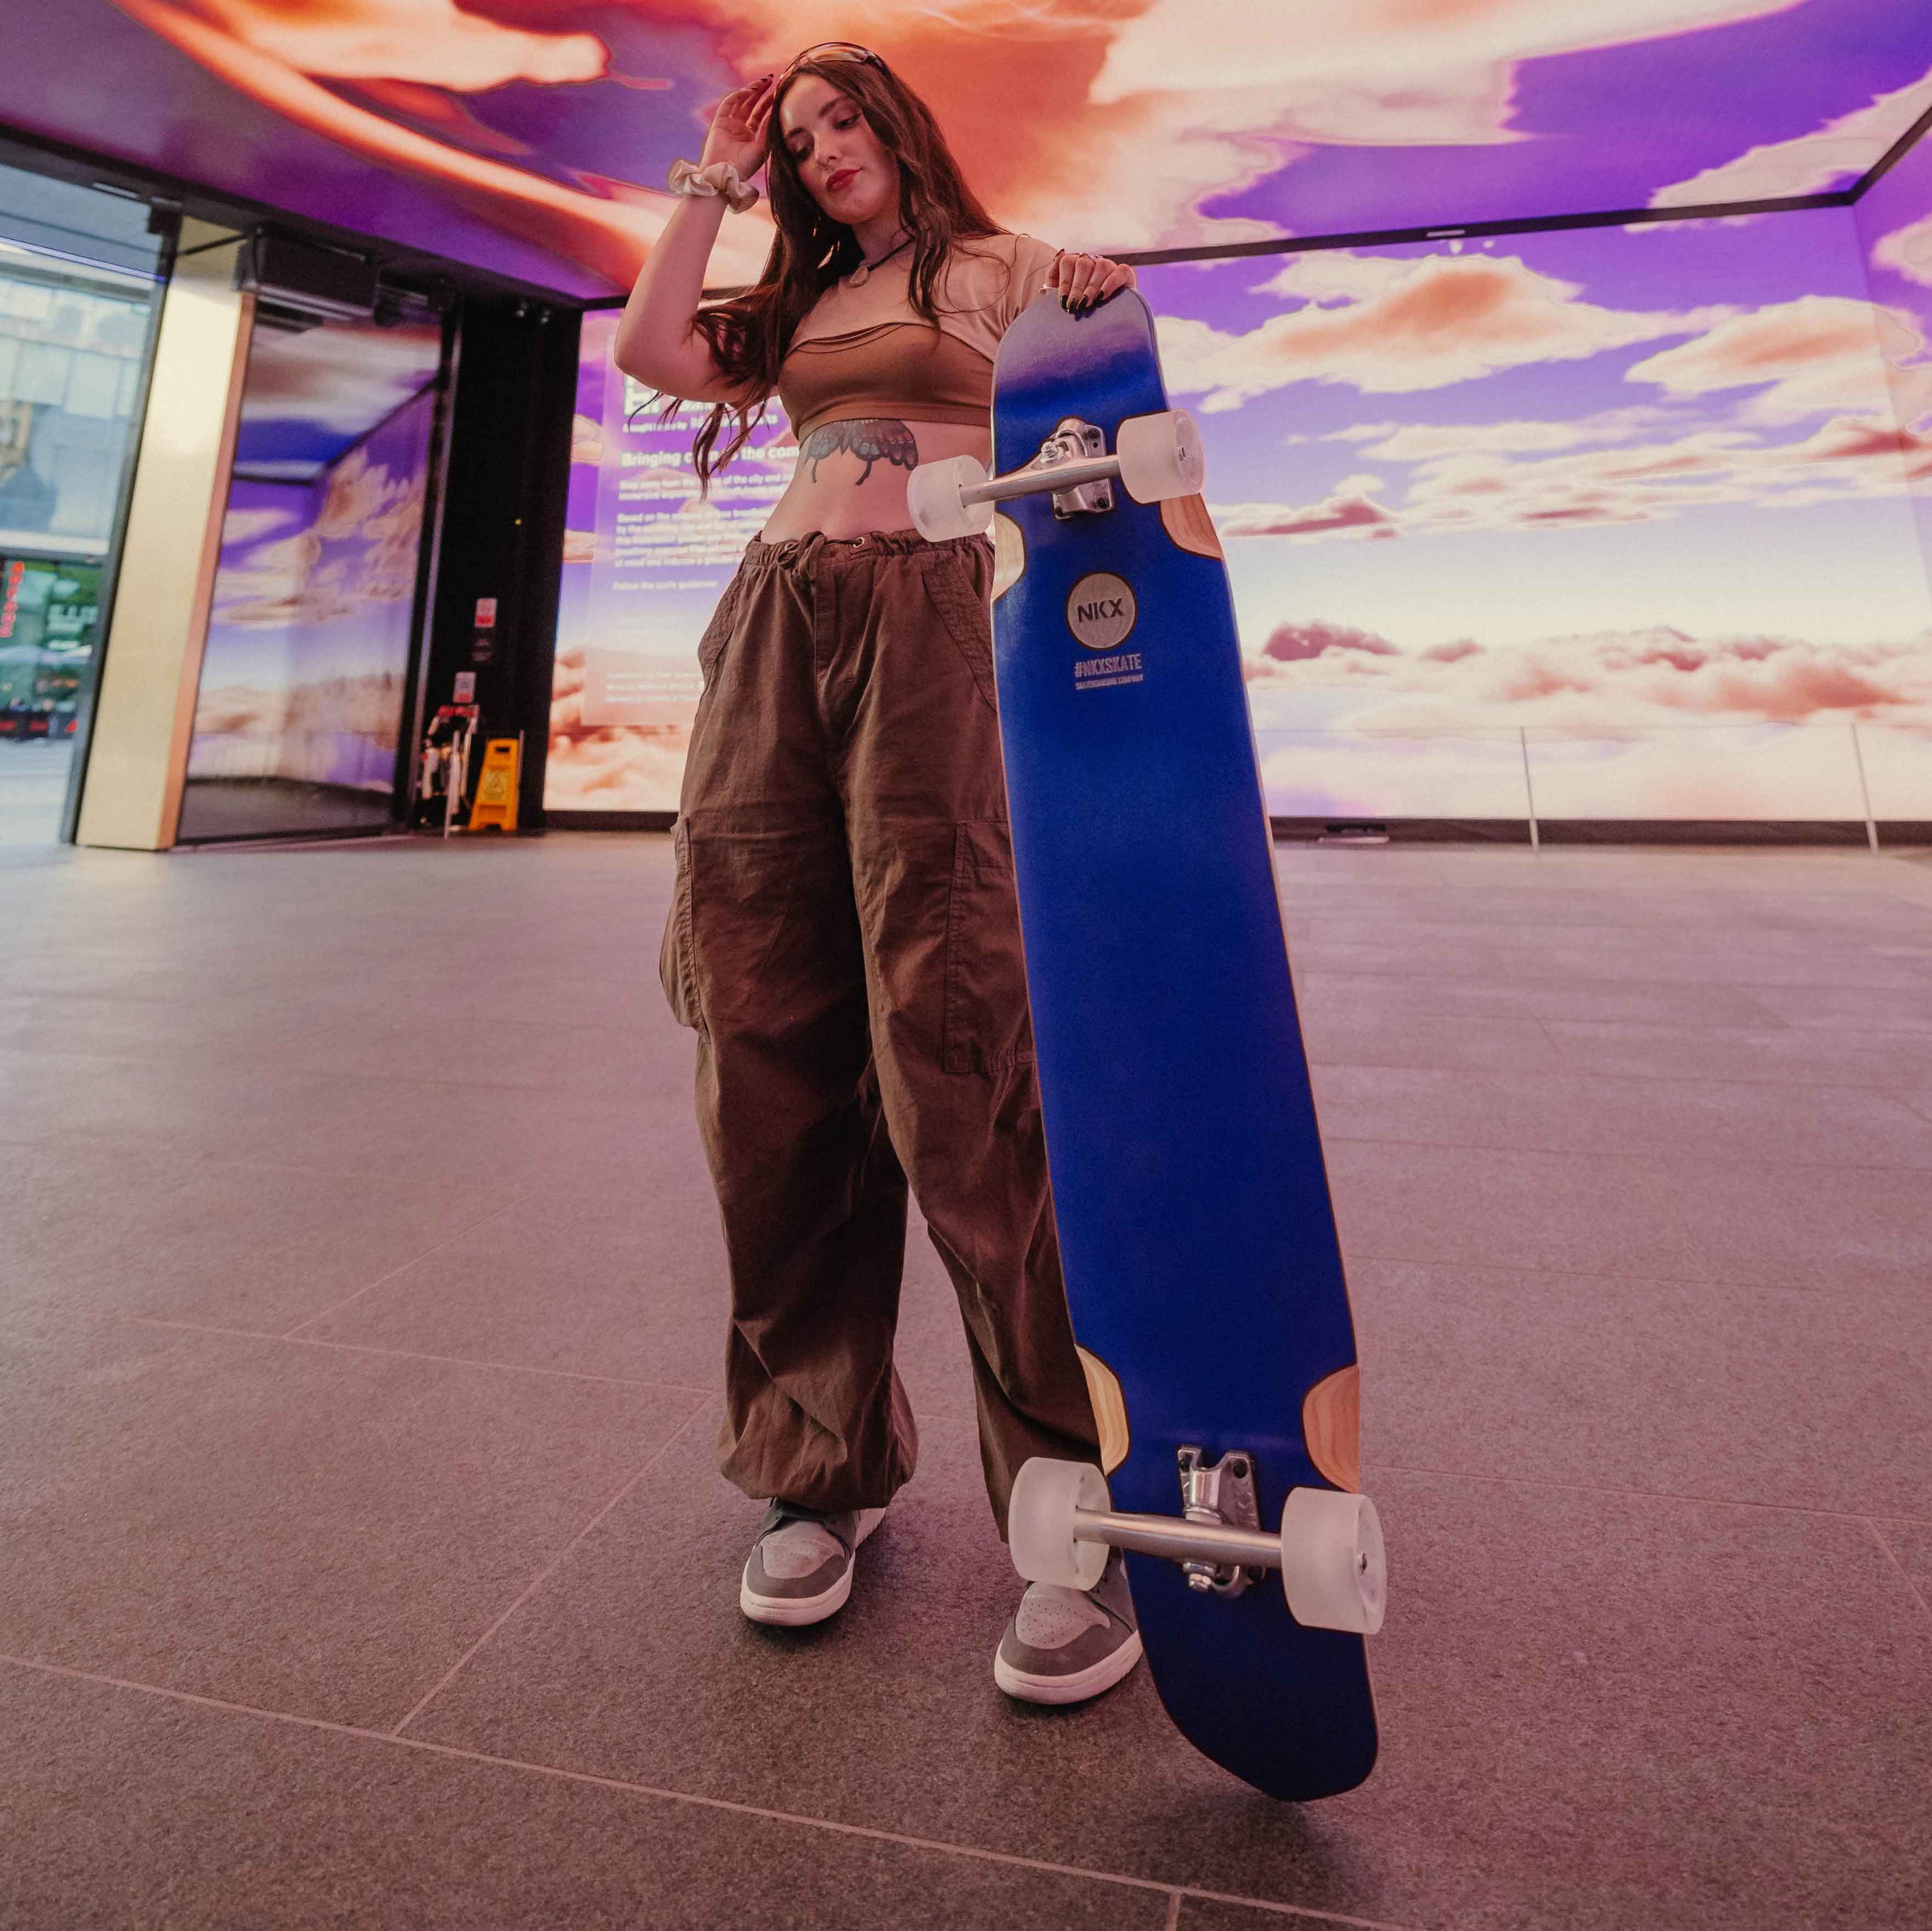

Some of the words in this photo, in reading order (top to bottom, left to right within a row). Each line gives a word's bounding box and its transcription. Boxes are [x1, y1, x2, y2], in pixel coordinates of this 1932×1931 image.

[621, 452, 681, 468] Bringing
[741, 446, 765, 460] the
[768, 446, 799, 459] com
[1077, 598, 1124, 622] NKX
